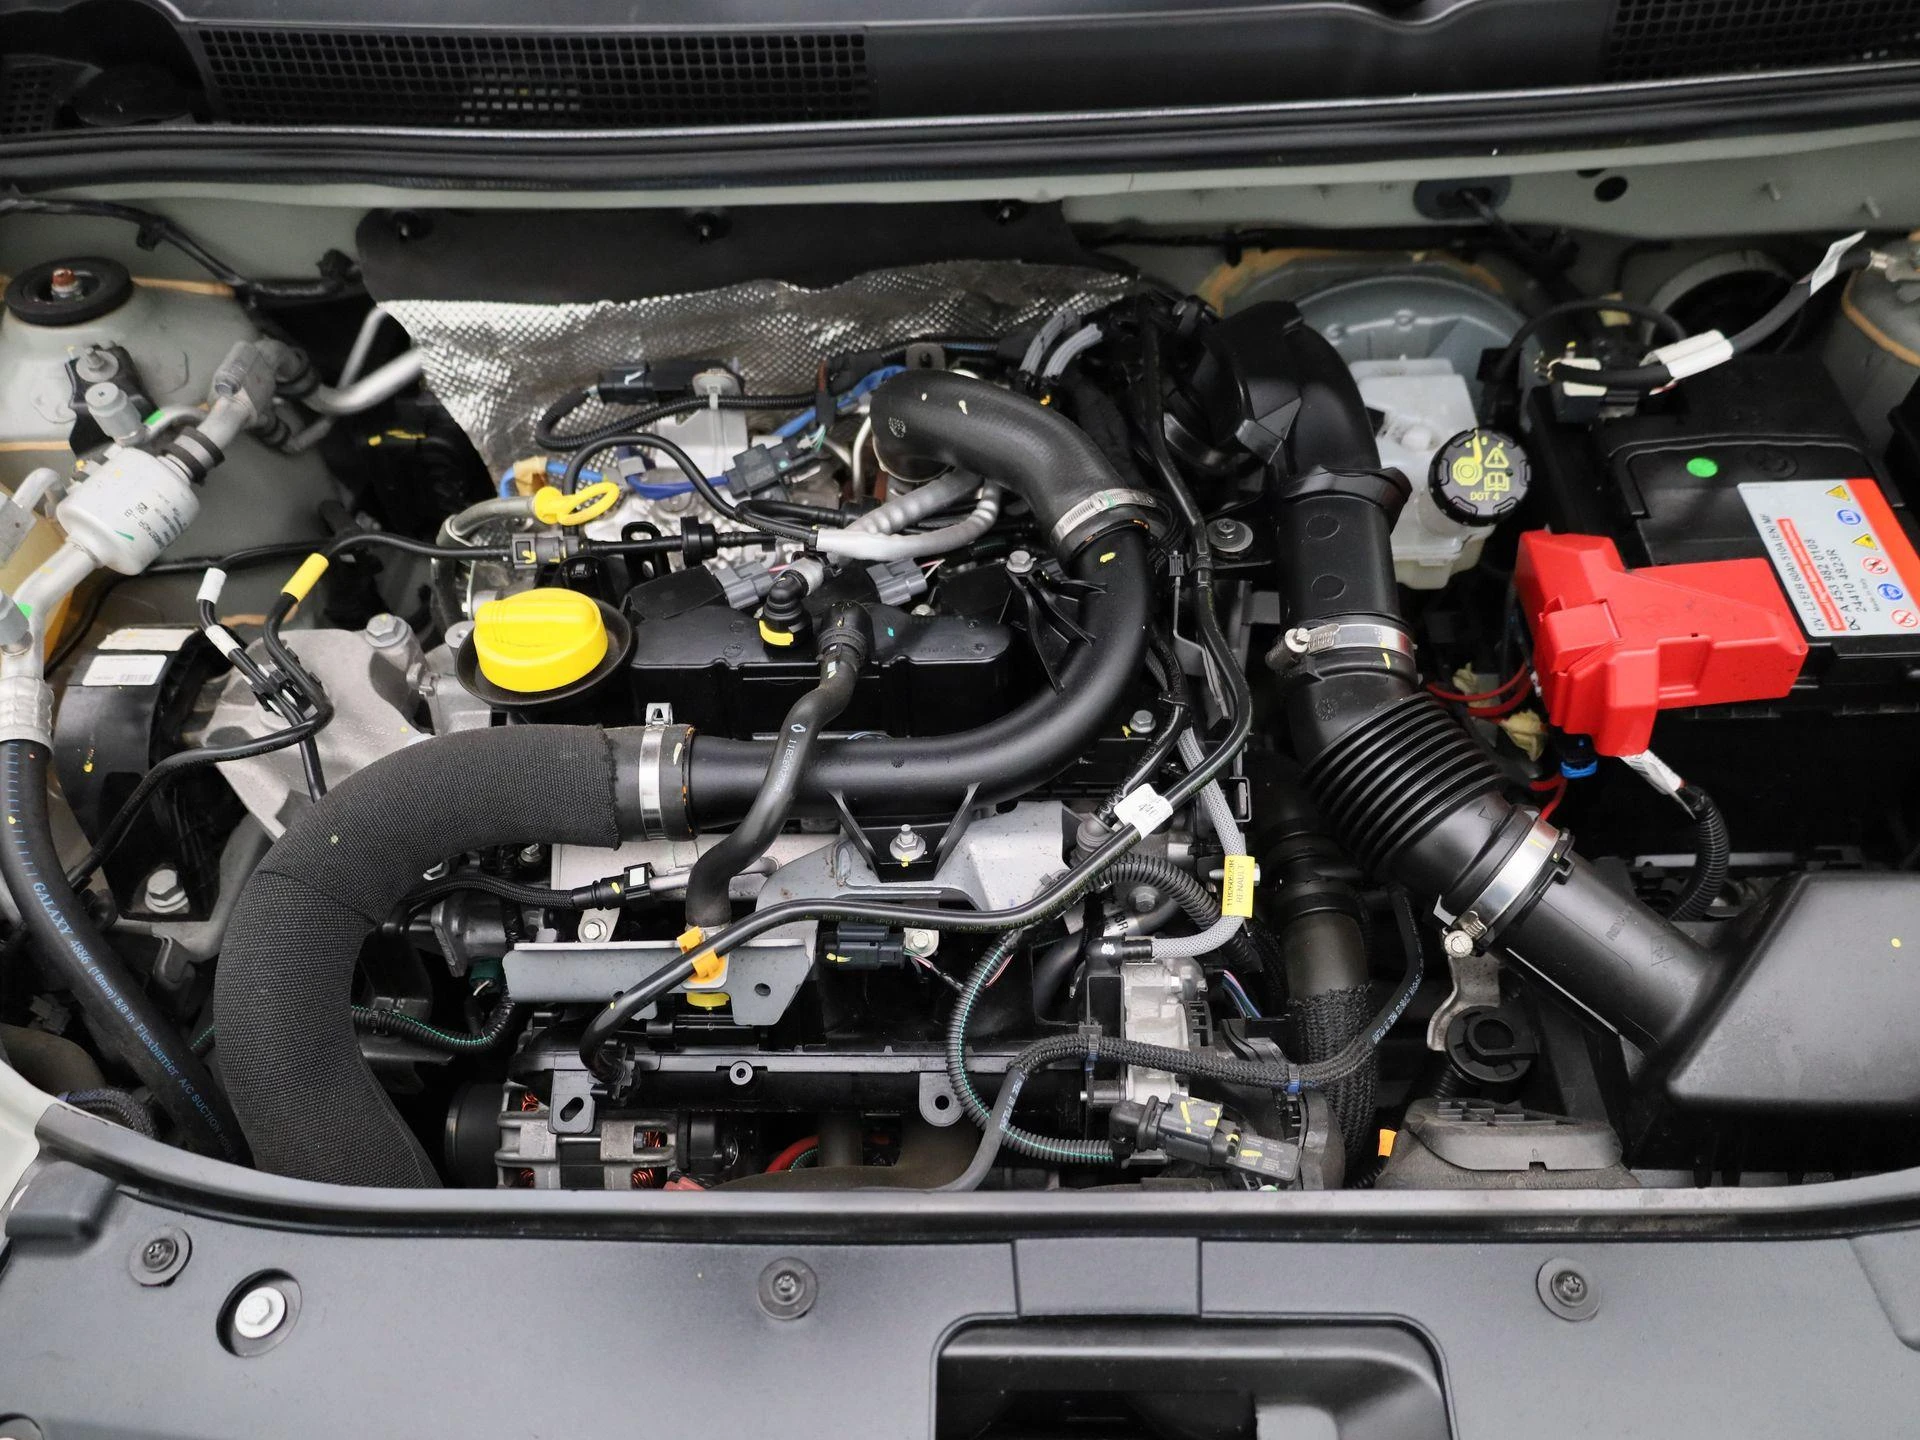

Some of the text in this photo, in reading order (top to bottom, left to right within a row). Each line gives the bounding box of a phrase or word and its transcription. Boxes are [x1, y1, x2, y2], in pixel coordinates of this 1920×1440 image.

[1470, 492, 1500, 501] DOT 4
[1818, 564, 1834, 580] 982
[1826, 549, 1867, 612] 24410 4823R
[1828, 584, 1845, 601] 453
[1839, 604, 1850, 612] A
[1236, 866, 1244, 903] RENAULT
[33, 882, 74, 936] GALAXY
[69, 939, 91, 965] 4886
[87, 966, 118, 999] (16mm)
[114, 997, 129, 1013] 5/8
[135, 1023, 178, 1077] Flexbarrier
[178, 1077, 194, 1095] A/C
[191, 1094, 221, 1134] SUCTION
